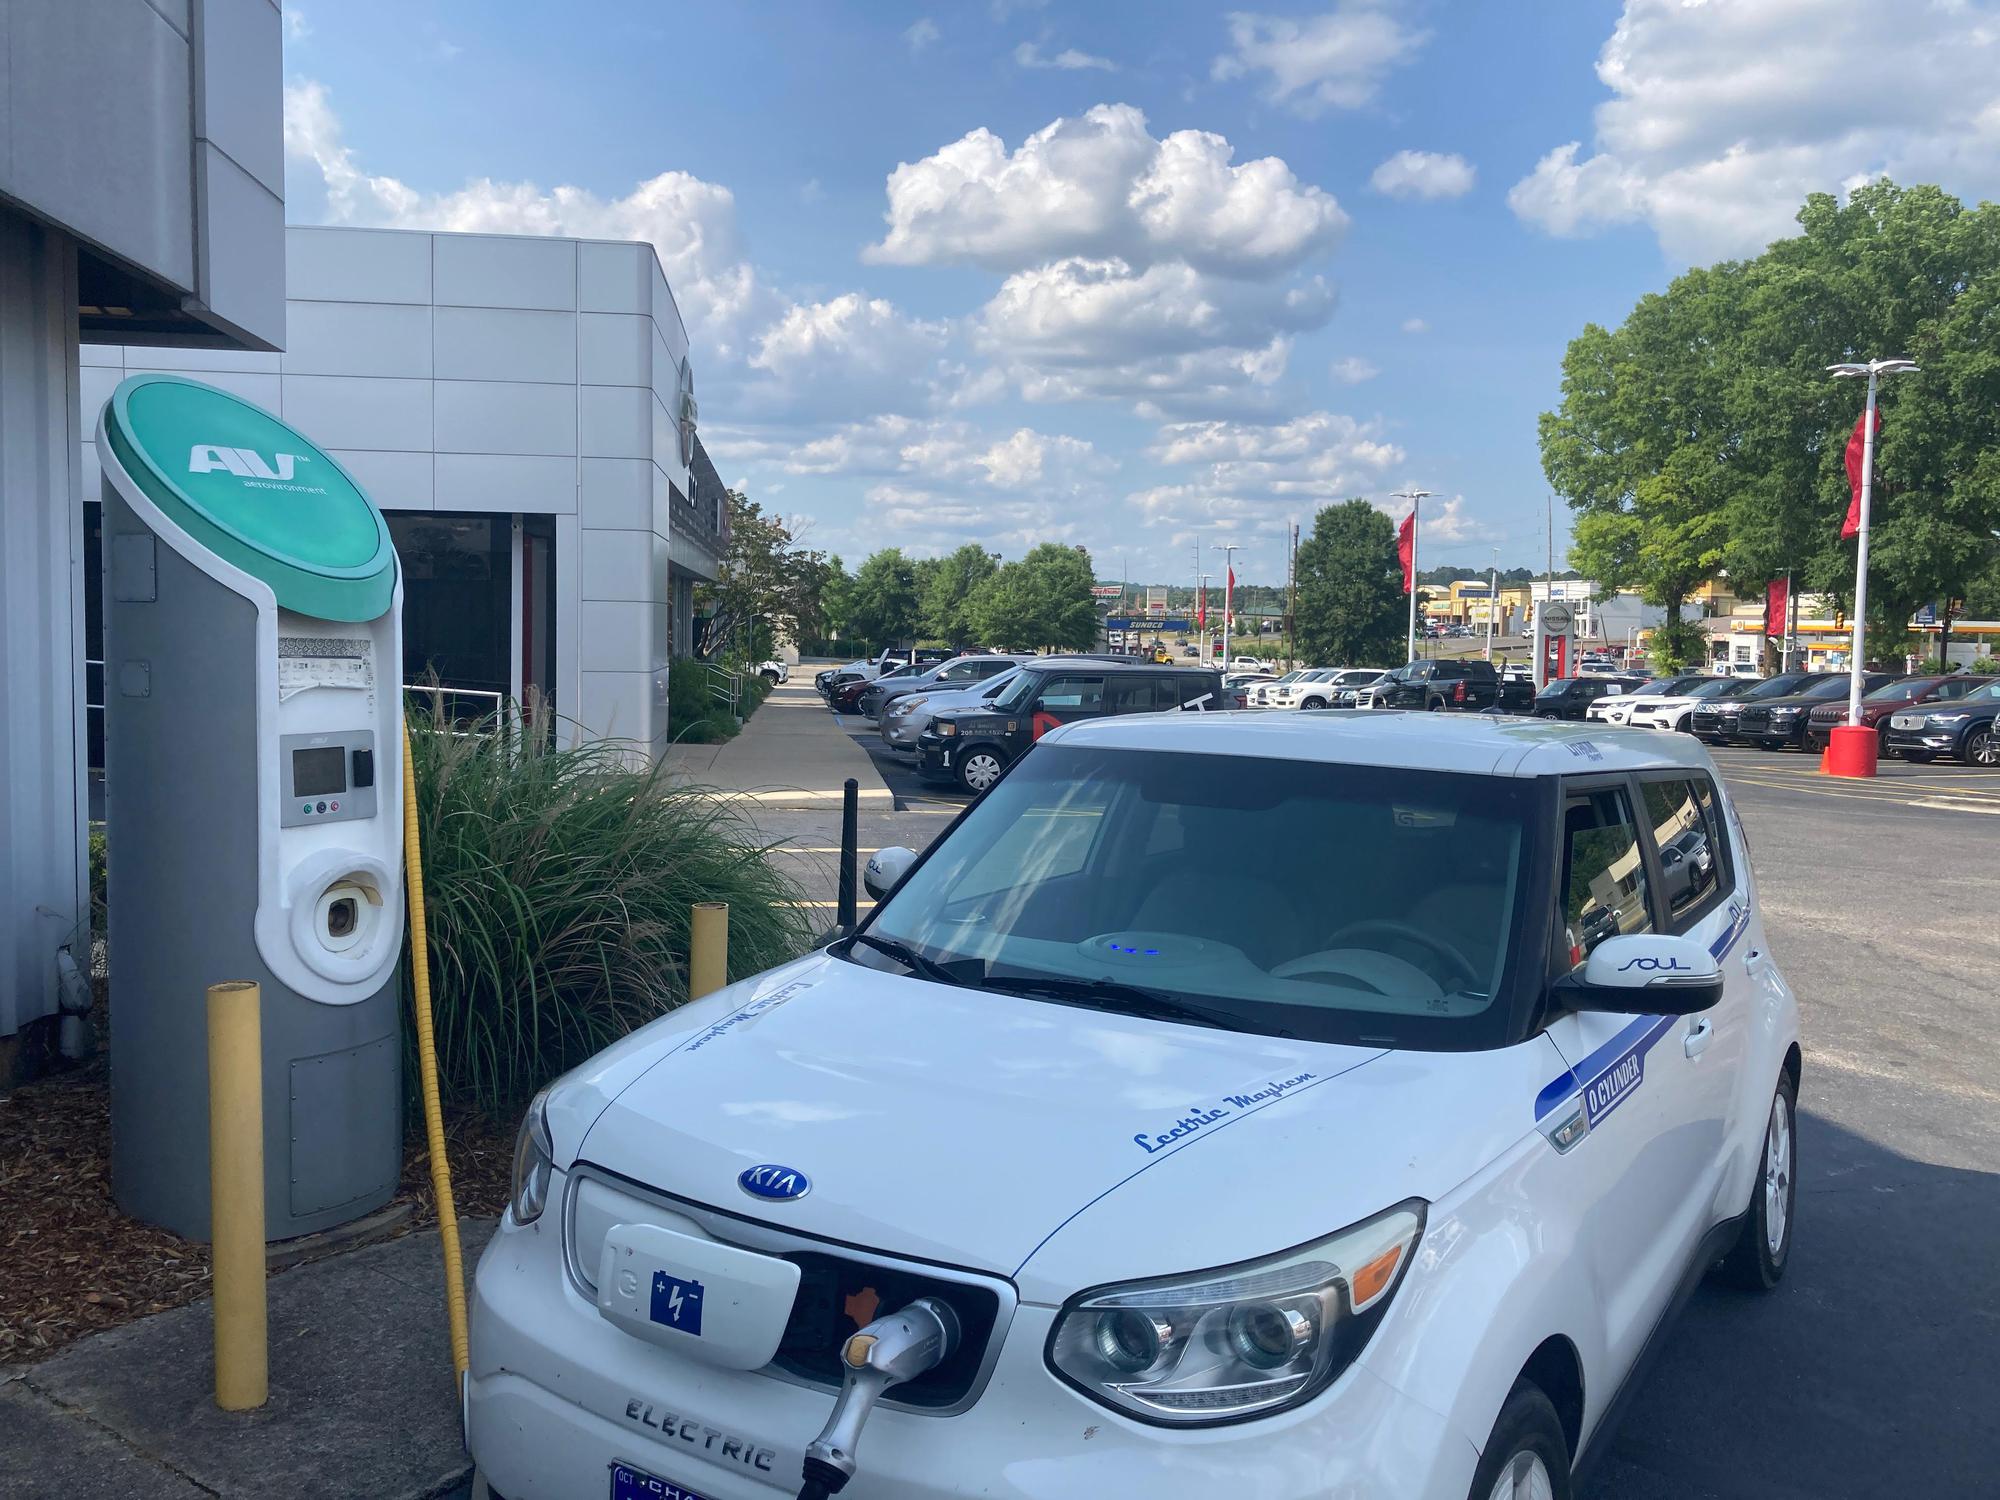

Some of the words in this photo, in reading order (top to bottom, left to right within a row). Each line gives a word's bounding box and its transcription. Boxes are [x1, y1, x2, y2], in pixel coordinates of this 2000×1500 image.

[242, 479, 328, 496] aerovironment
[1129, 621, 1164, 629] SUNOCO
[943, 750, 950, 767] 1
[1597, 1054, 1640, 1106] CYLINDER
[1133, 1108, 1230, 1154] Lectric
[1223, 1072, 1317, 1109] Mayhem
[747, 1166, 798, 1194] KIA
[625, 1398, 777, 1472] ELECTRIC
[618, 1470, 634, 1485] OCT
